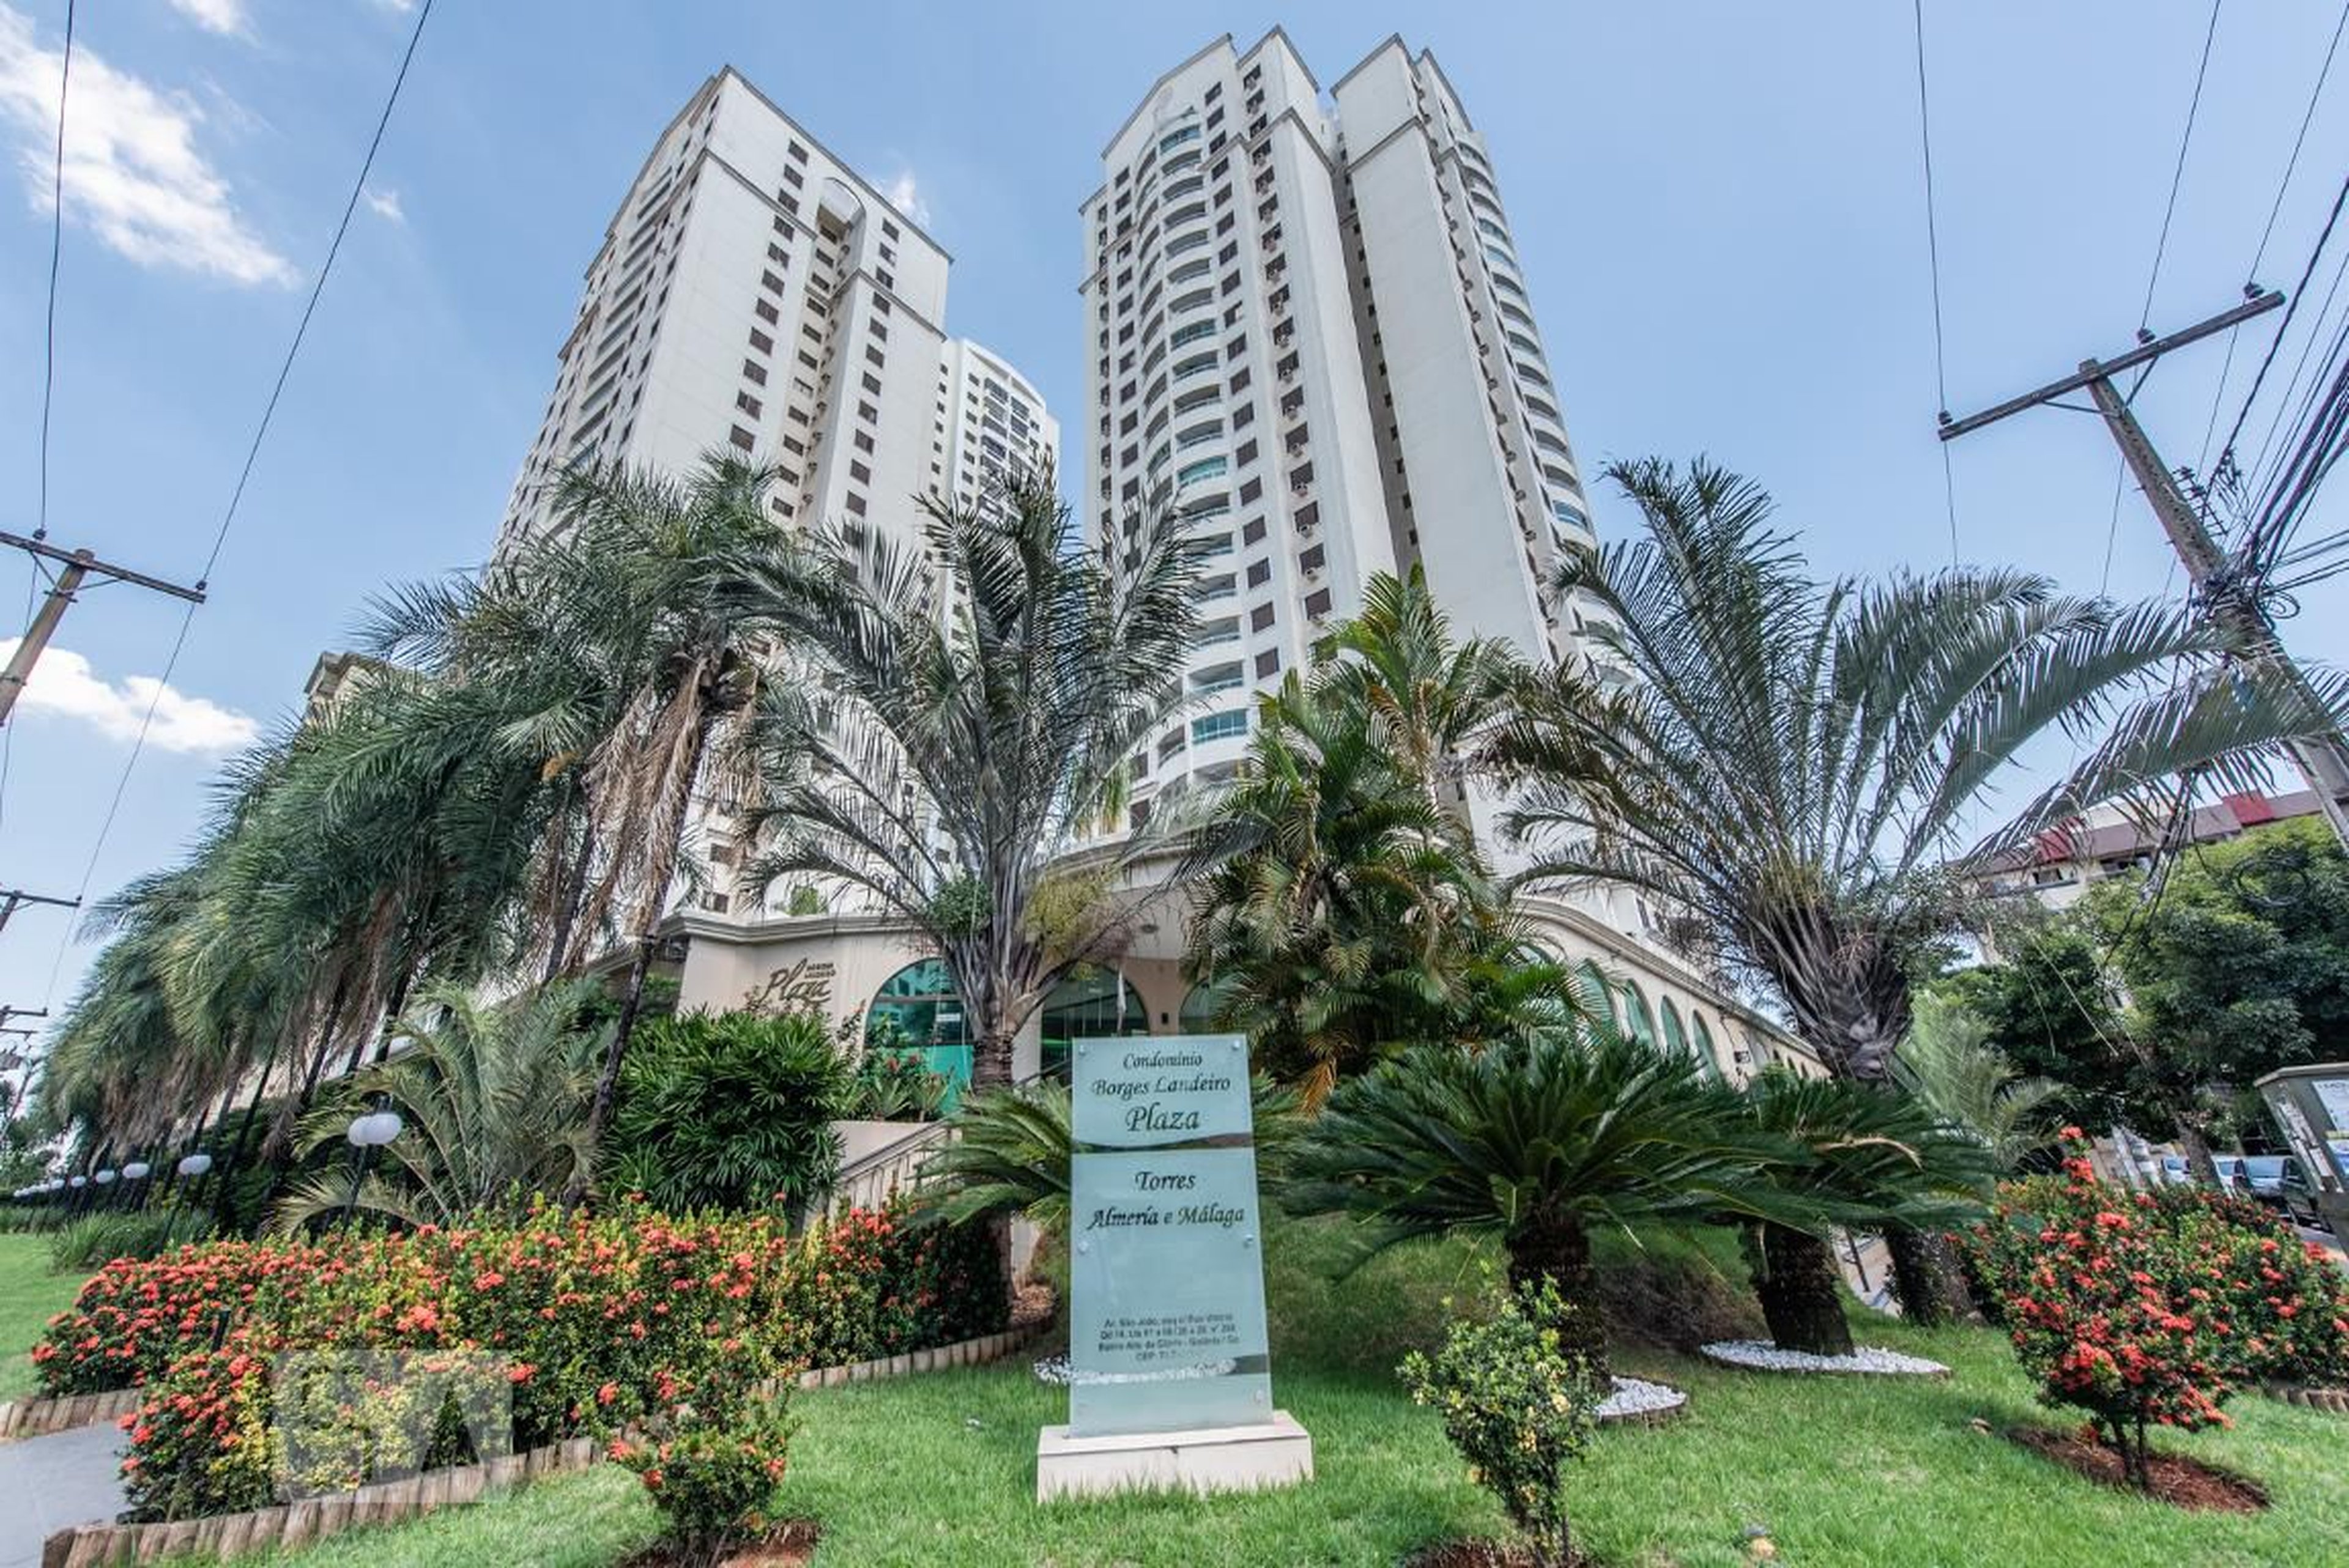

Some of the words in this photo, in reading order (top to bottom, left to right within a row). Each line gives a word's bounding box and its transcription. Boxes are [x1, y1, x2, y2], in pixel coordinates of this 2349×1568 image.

[1123, 1050, 1203, 1070] Condomínio
[1091, 1078, 1149, 1101] Borges
[1154, 1073, 1231, 1093] Landeiro
[1125, 1101, 1200, 1132] Plaza
[1135, 1170, 1197, 1191] Torres
[1086, 1205, 1159, 1230] Almería
[1163, 1211, 1174, 1224] e
[1177, 1202, 1245, 1228] Málaga
